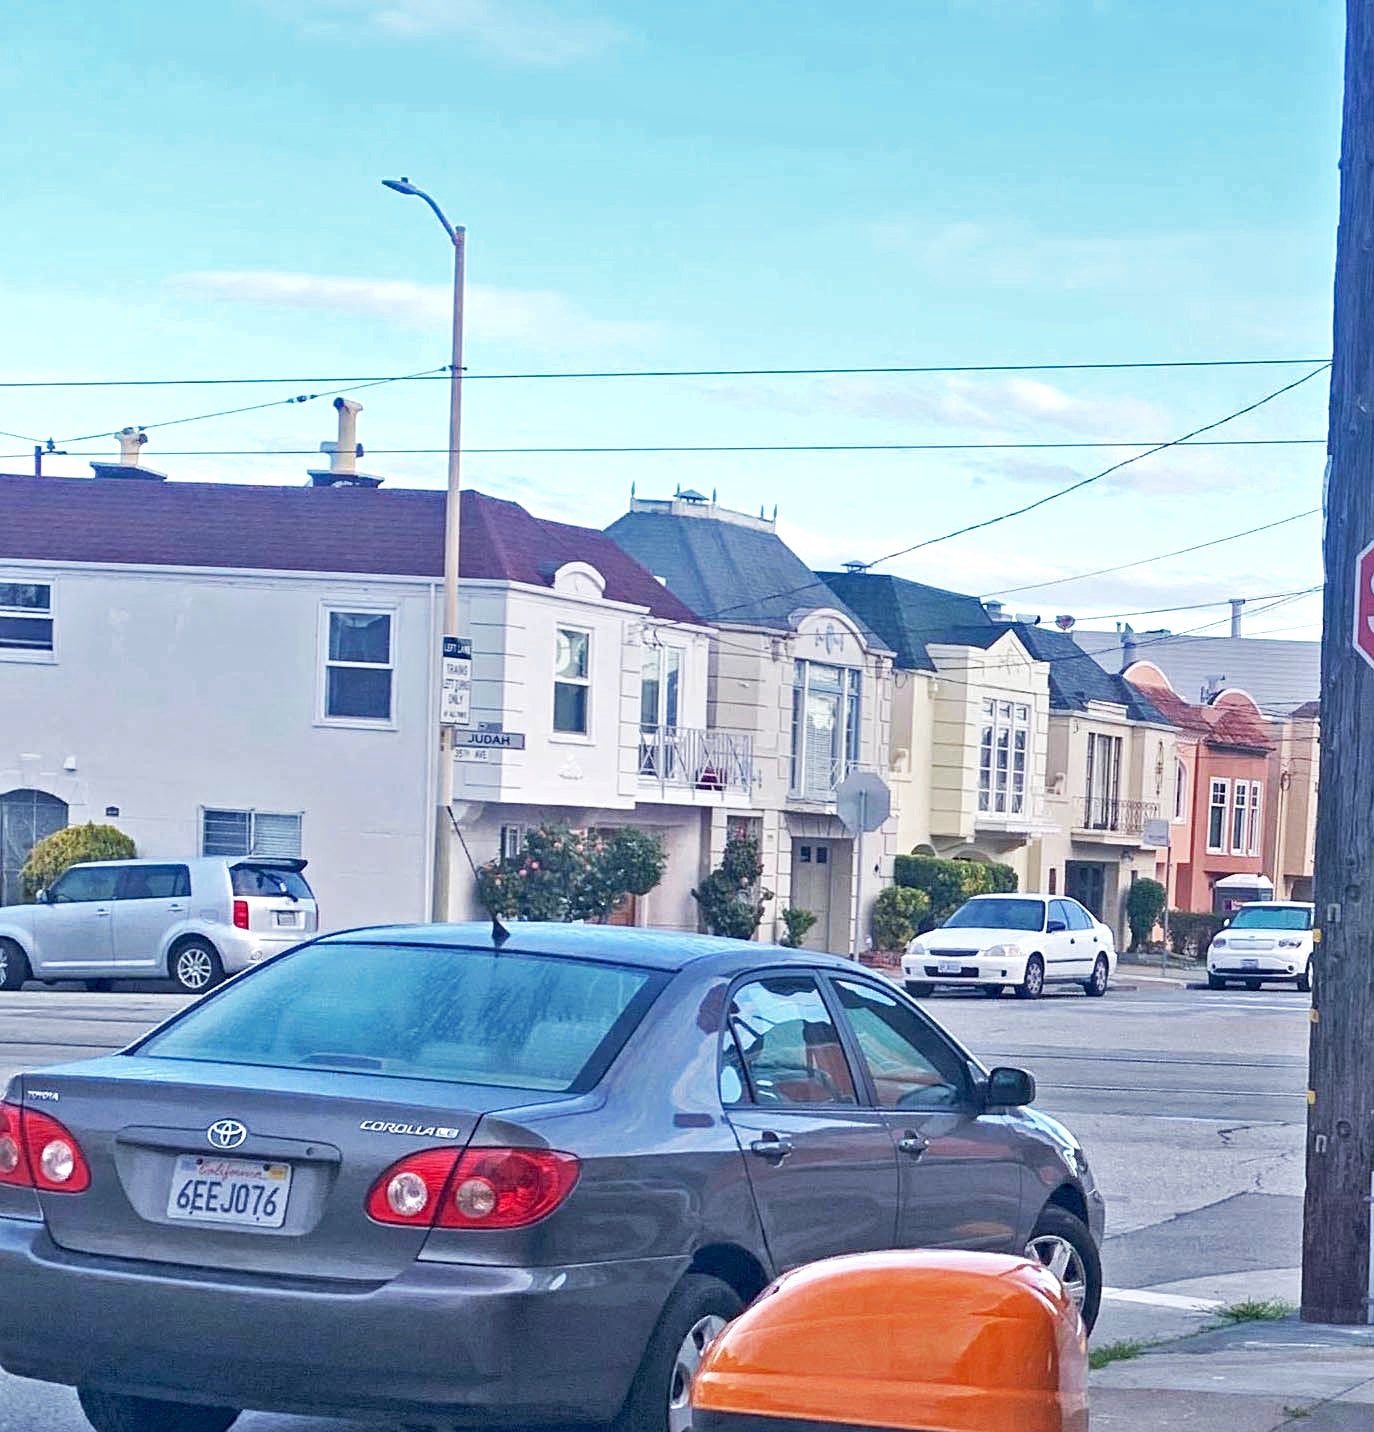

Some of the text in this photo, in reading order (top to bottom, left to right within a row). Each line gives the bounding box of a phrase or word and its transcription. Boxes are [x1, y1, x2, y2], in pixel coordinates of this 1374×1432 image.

[468, 733, 511, 745] JUDAH
[360, 1120, 435, 1135] COROLLA
[199, 1161, 262, 1180] California
[177, 1180, 280, 1217] 6EEJ076
